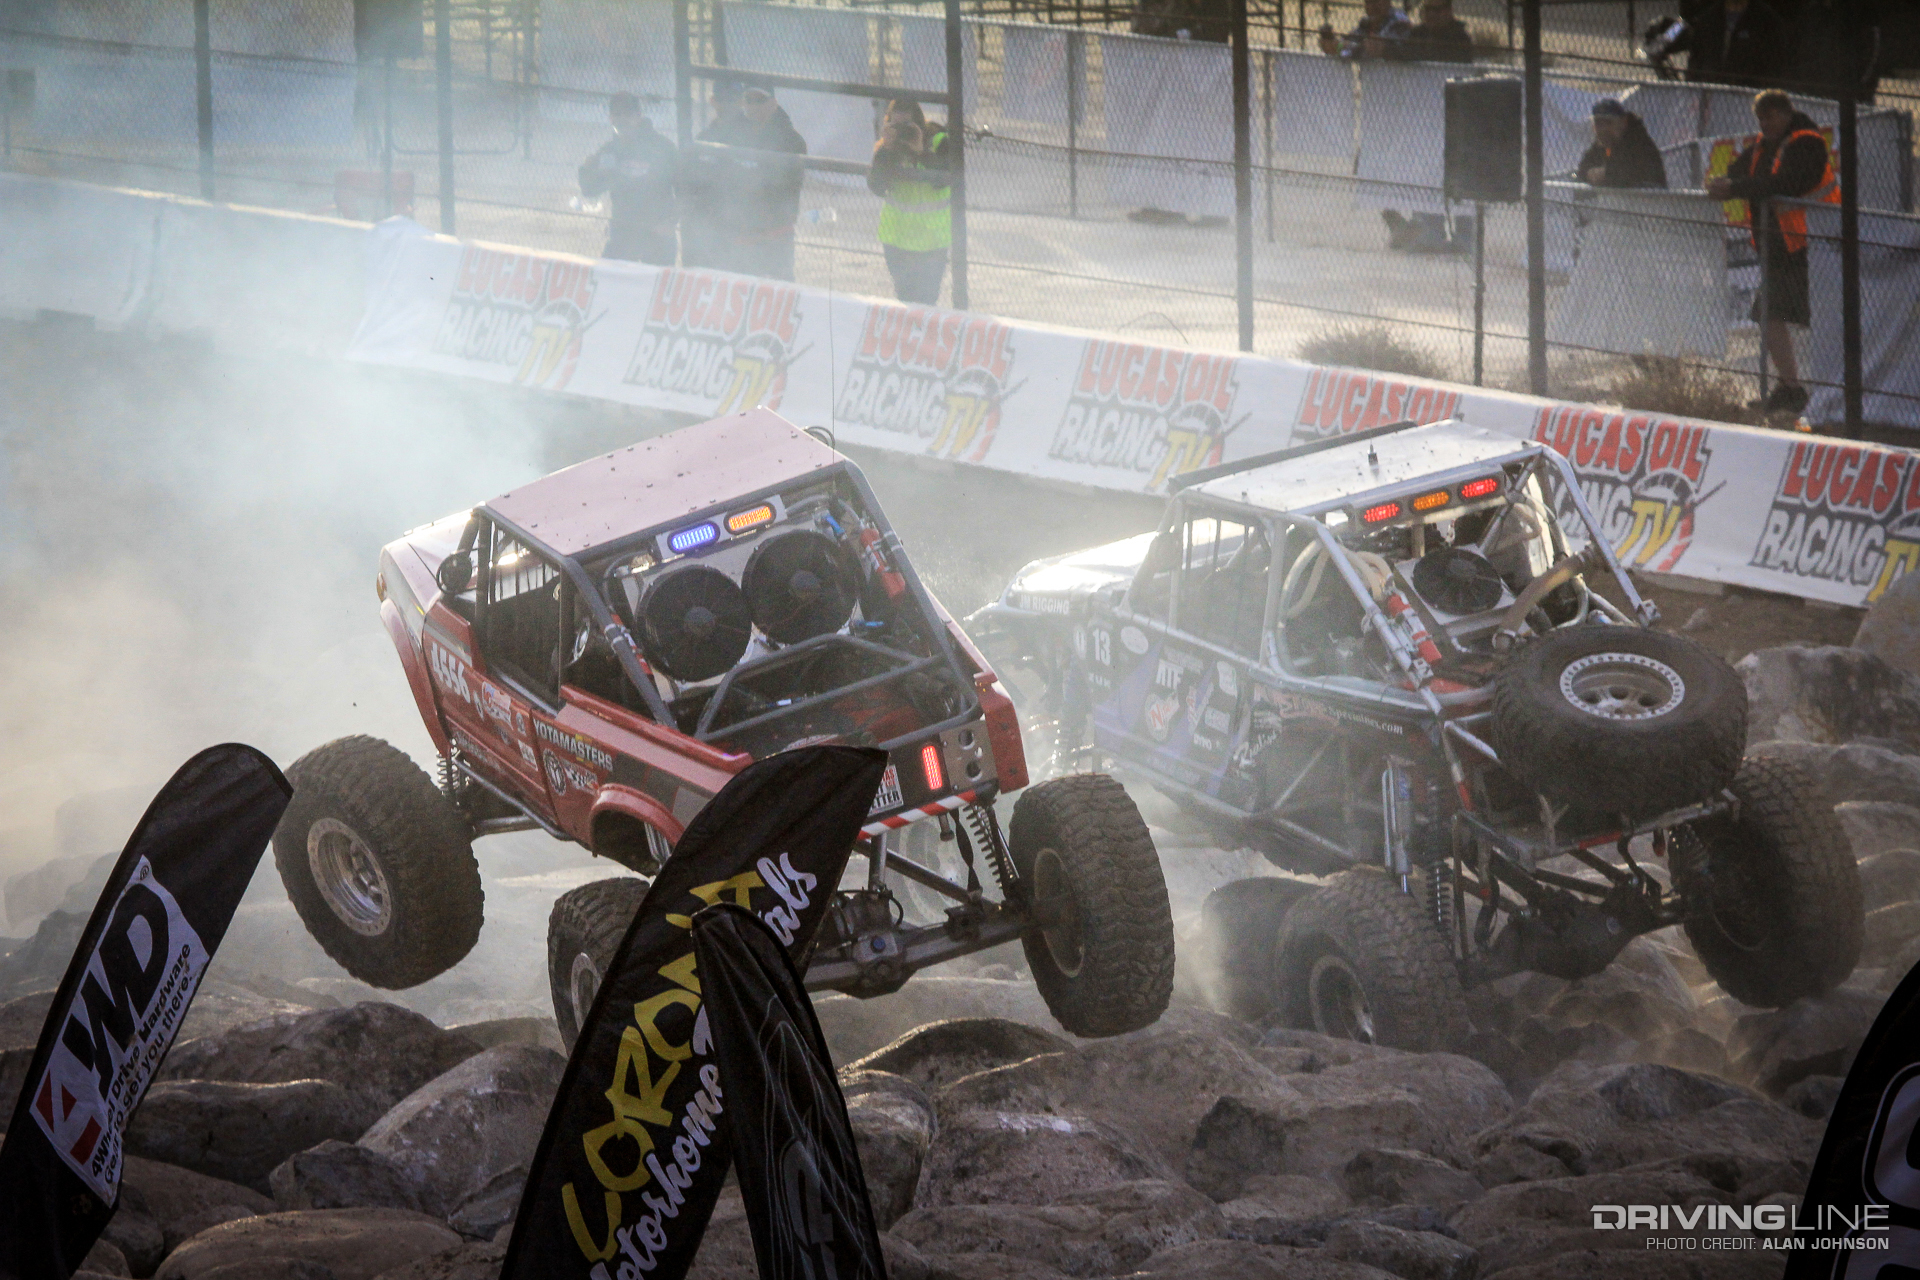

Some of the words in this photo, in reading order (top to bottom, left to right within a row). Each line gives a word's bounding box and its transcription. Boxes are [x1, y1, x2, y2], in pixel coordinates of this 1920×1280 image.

[456, 247, 549, 306] LUCAS
[549, 260, 598, 310] OIL
[650, 268, 748, 336] LUCAS
[748, 284, 800, 344] OIL
[434, 302, 534, 366] RACING
[515, 325, 572, 385] TV
[624, 332, 735, 400] RACING
[715, 357, 776, 416] TV
[860, 304, 964, 371] LUCAS
[960, 319, 1012, 381] OIL
[1076, 338, 1186, 407] LUCAS
[1184, 353, 1238, 413] OIL
[834, 368, 948, 438] RACING
[928, 395, 990, 454] TV
[1050, 402, 1171, 472] RACING
[1148, 429, 1213, 489] TV
[1535, 406, 1650, 475] LUCAS
[1650, 420, 1704, 482] OIL
[1782, 441, 1908, 513] LUCAS
[1615, 500, 1682, 564] TV
[1752, 509, 1886, 584] RACING
[1032, 596, 1070, 616] RIGGING
[1092, 628, 1111, 666] 13
[533, 718, 614, 773] YOTAMASTERS
[35, 882, 170, 1165] 4WD
[111, 1046, 141, 1099] Drive
[138, 943, 191, 1044] Hardware
[142, 1035, 165, 1077] you
